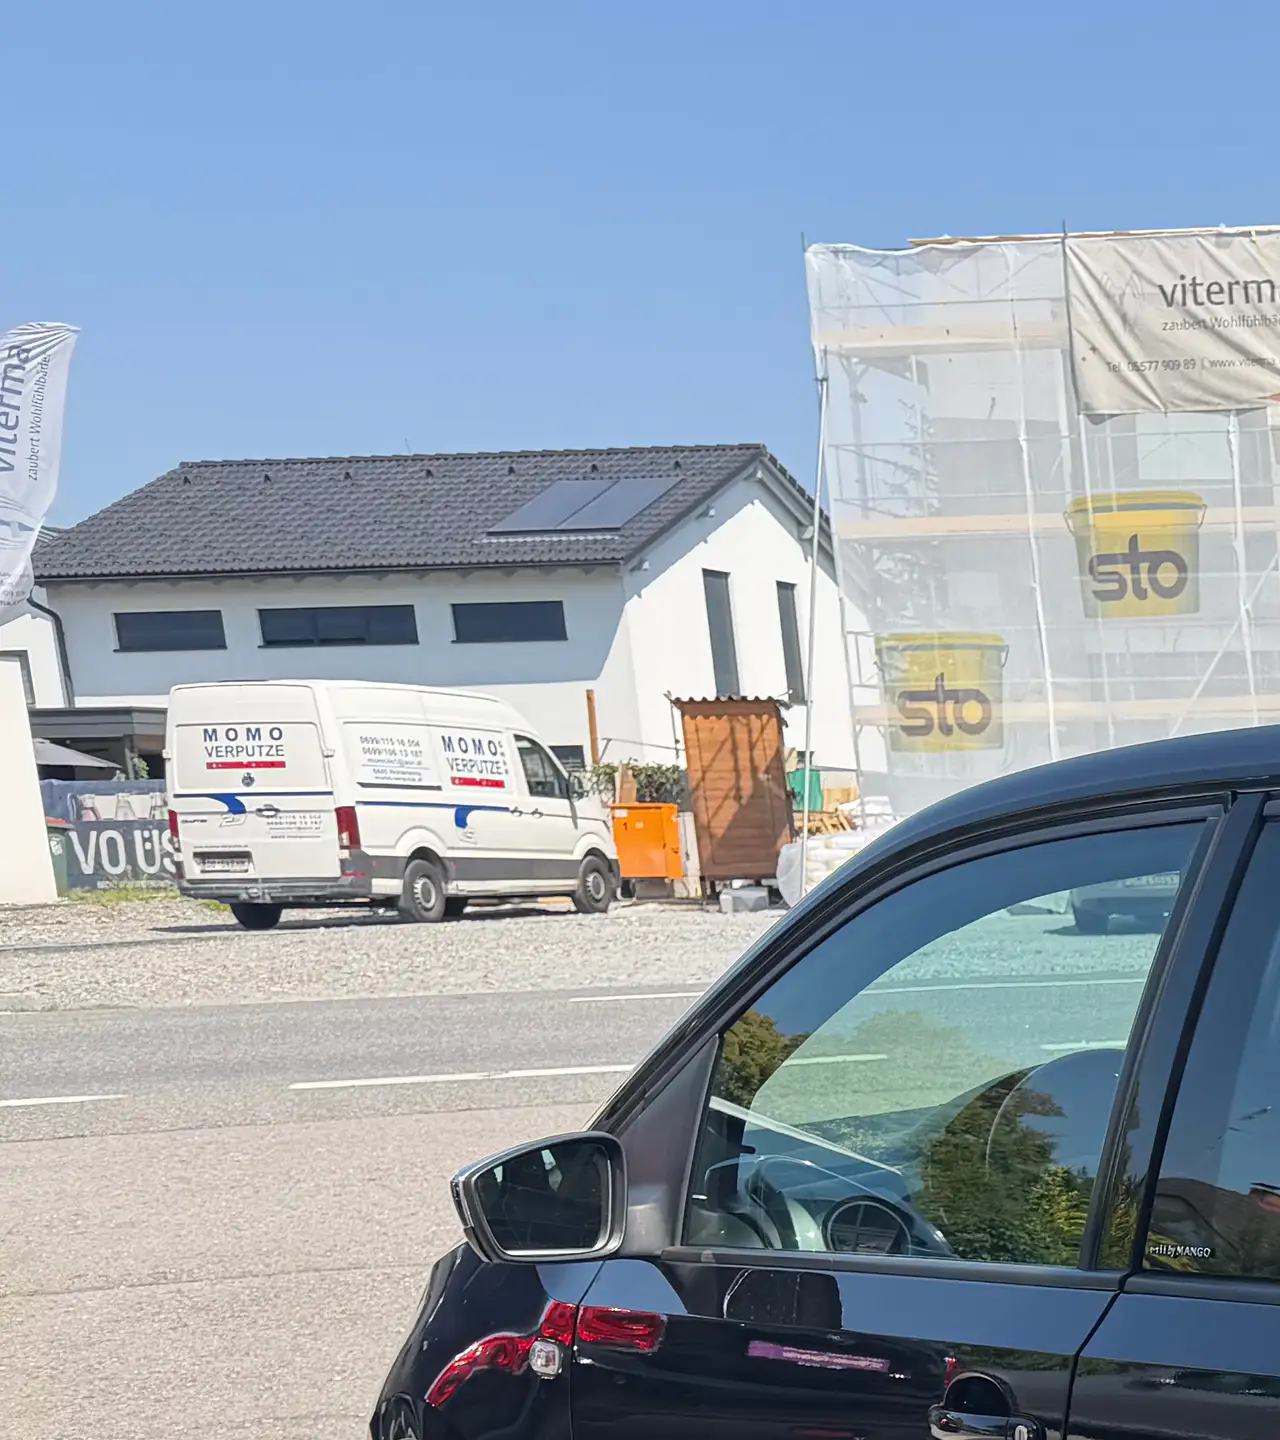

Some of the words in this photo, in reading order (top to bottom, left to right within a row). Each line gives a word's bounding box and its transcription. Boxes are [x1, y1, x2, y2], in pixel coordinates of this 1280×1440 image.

[1162, 358, 1182, 372] 909
[1183, 358, 1197, 370] 89
[28, 436, 41, 481] zaubert
[1088, 533, 1189, 602] sto
[898, 672, 992, 737] sto
[203, 726, 284, 742] MOMO
[204, 744, 285, 758] VERPUTZE
[441, 735, 498, 757] MOMO
[446, 757, 503, 776] VERPUTZE
[1176, 1245, 1212, 1258] MANGO
